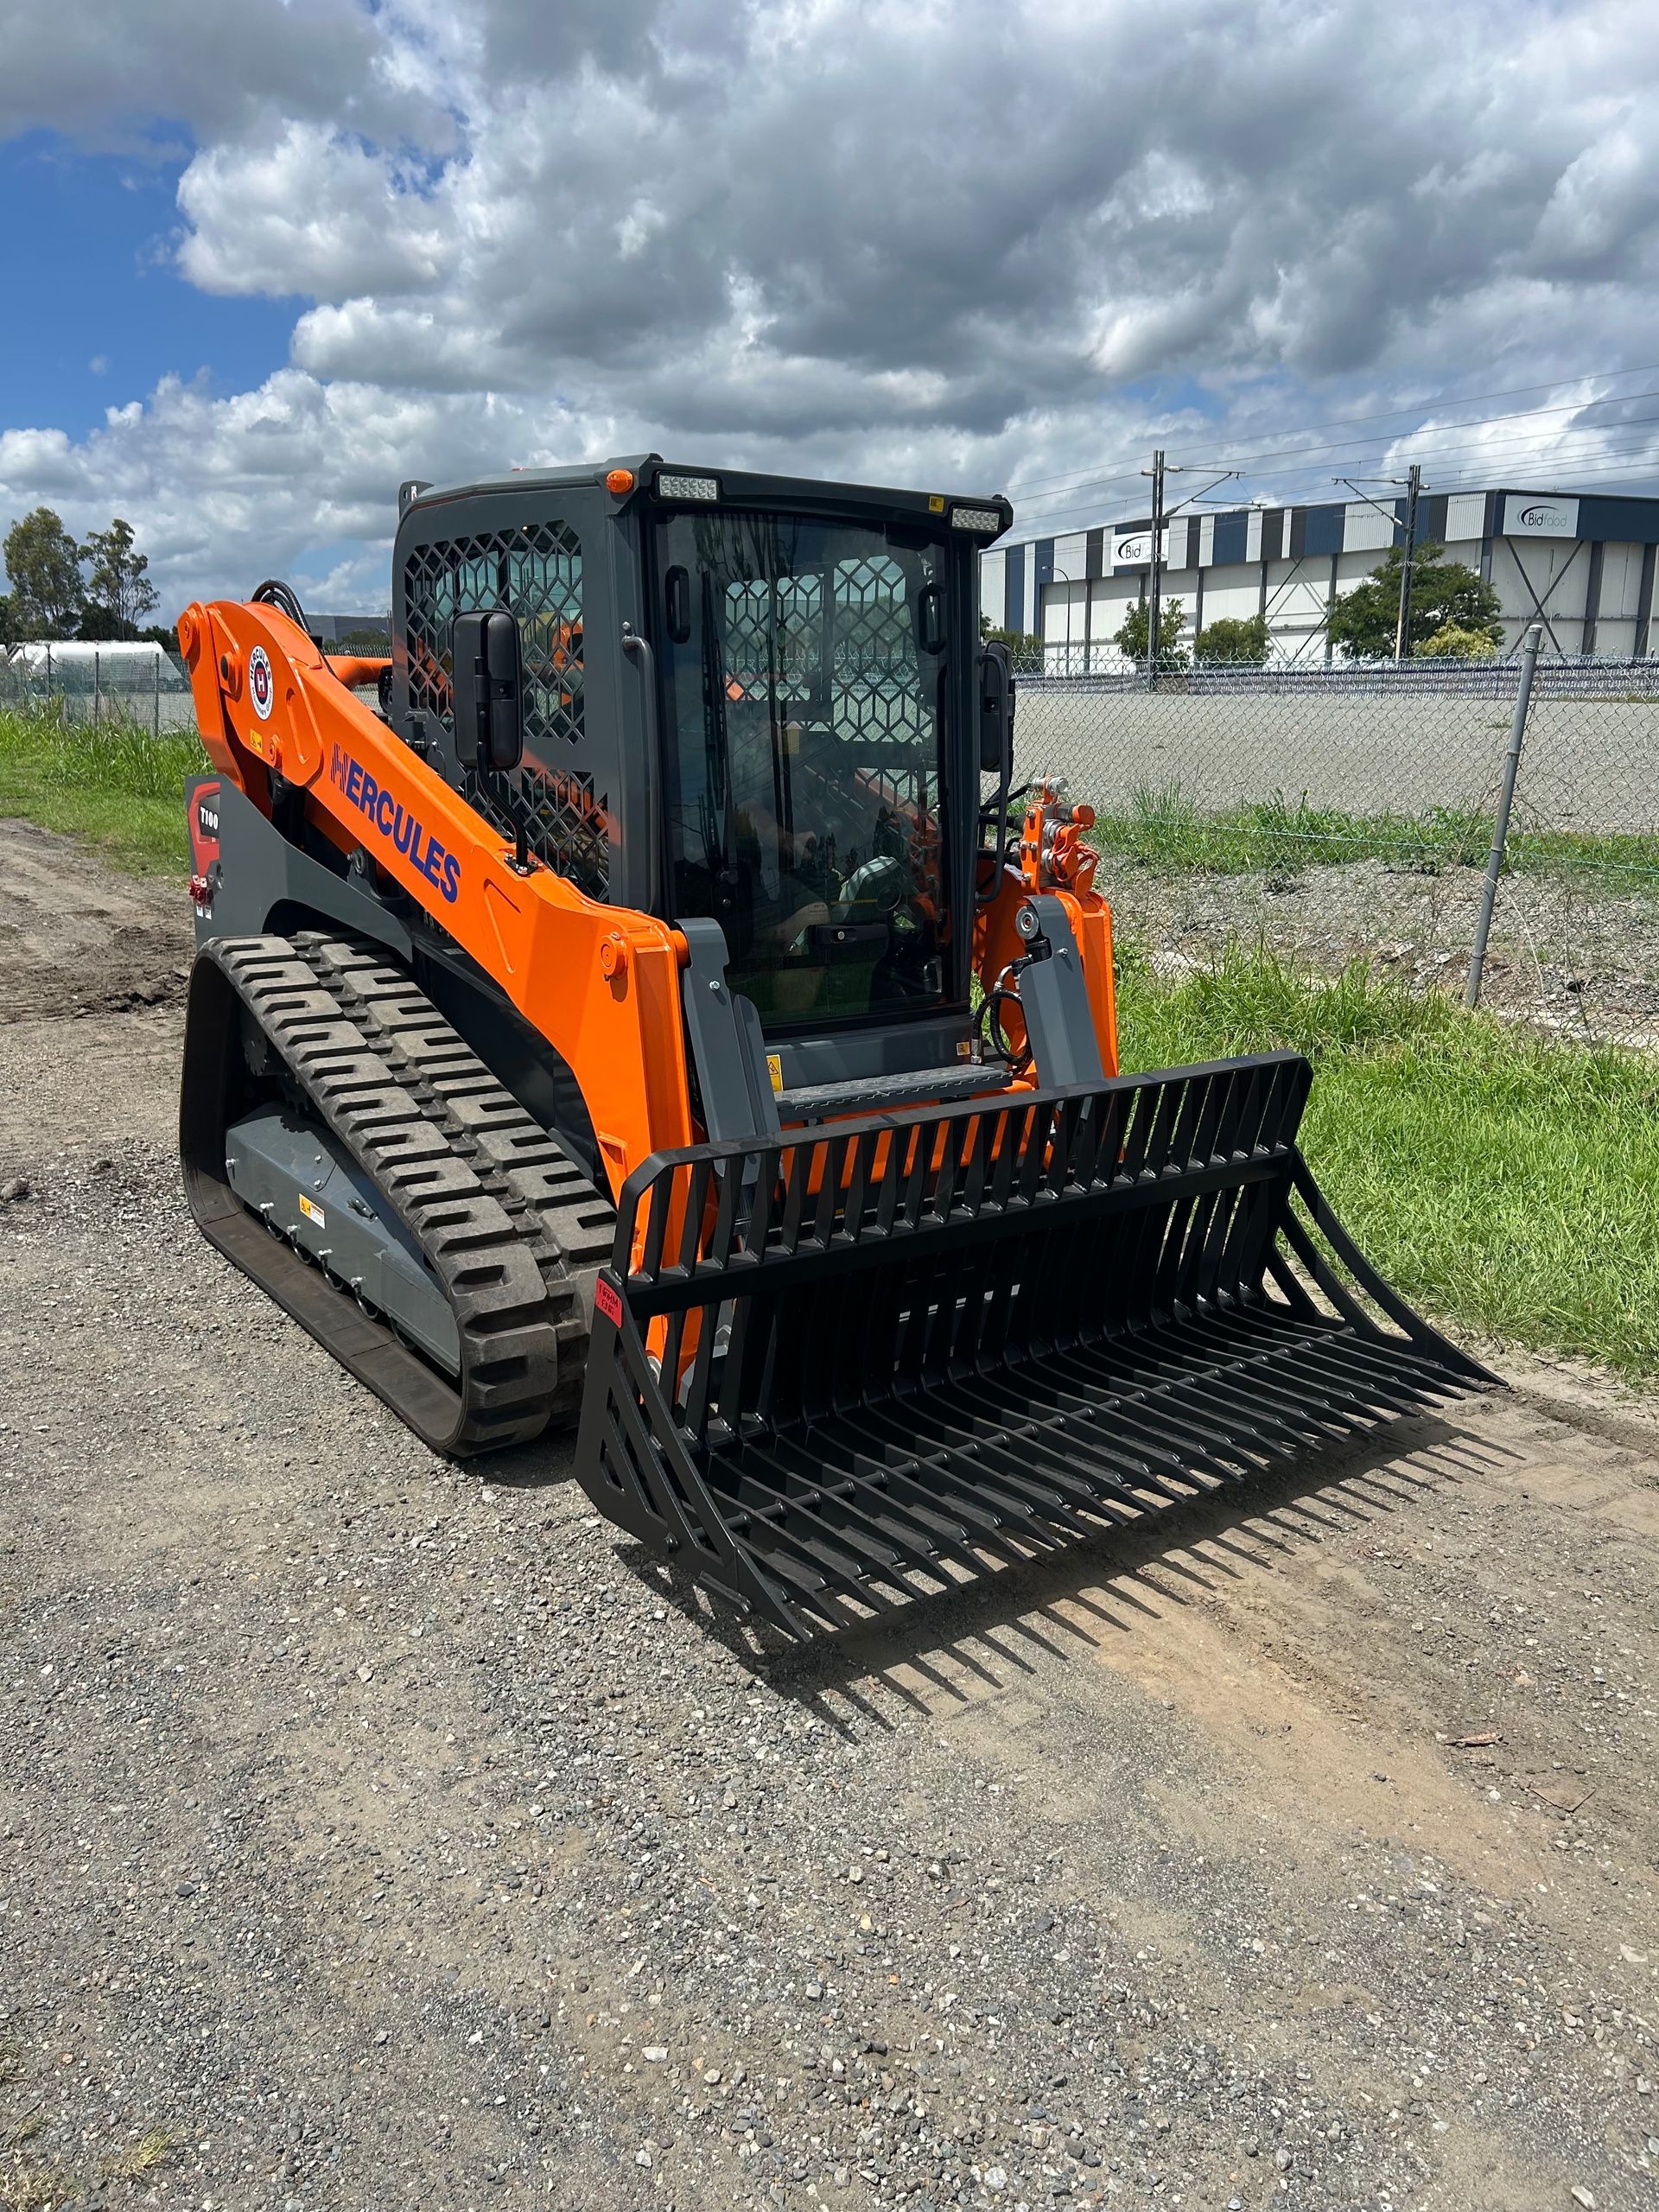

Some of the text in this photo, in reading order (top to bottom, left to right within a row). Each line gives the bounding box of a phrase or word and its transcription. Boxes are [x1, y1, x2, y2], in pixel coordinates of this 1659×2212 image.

[1528, 512, 1567, 527] Bidfood
[250, 647, 271, 681] HERCULES
[257, 673, 265, 692] H
[200, 805, 219, 830] T100
[330, 741, 461, 903] HERCULES
